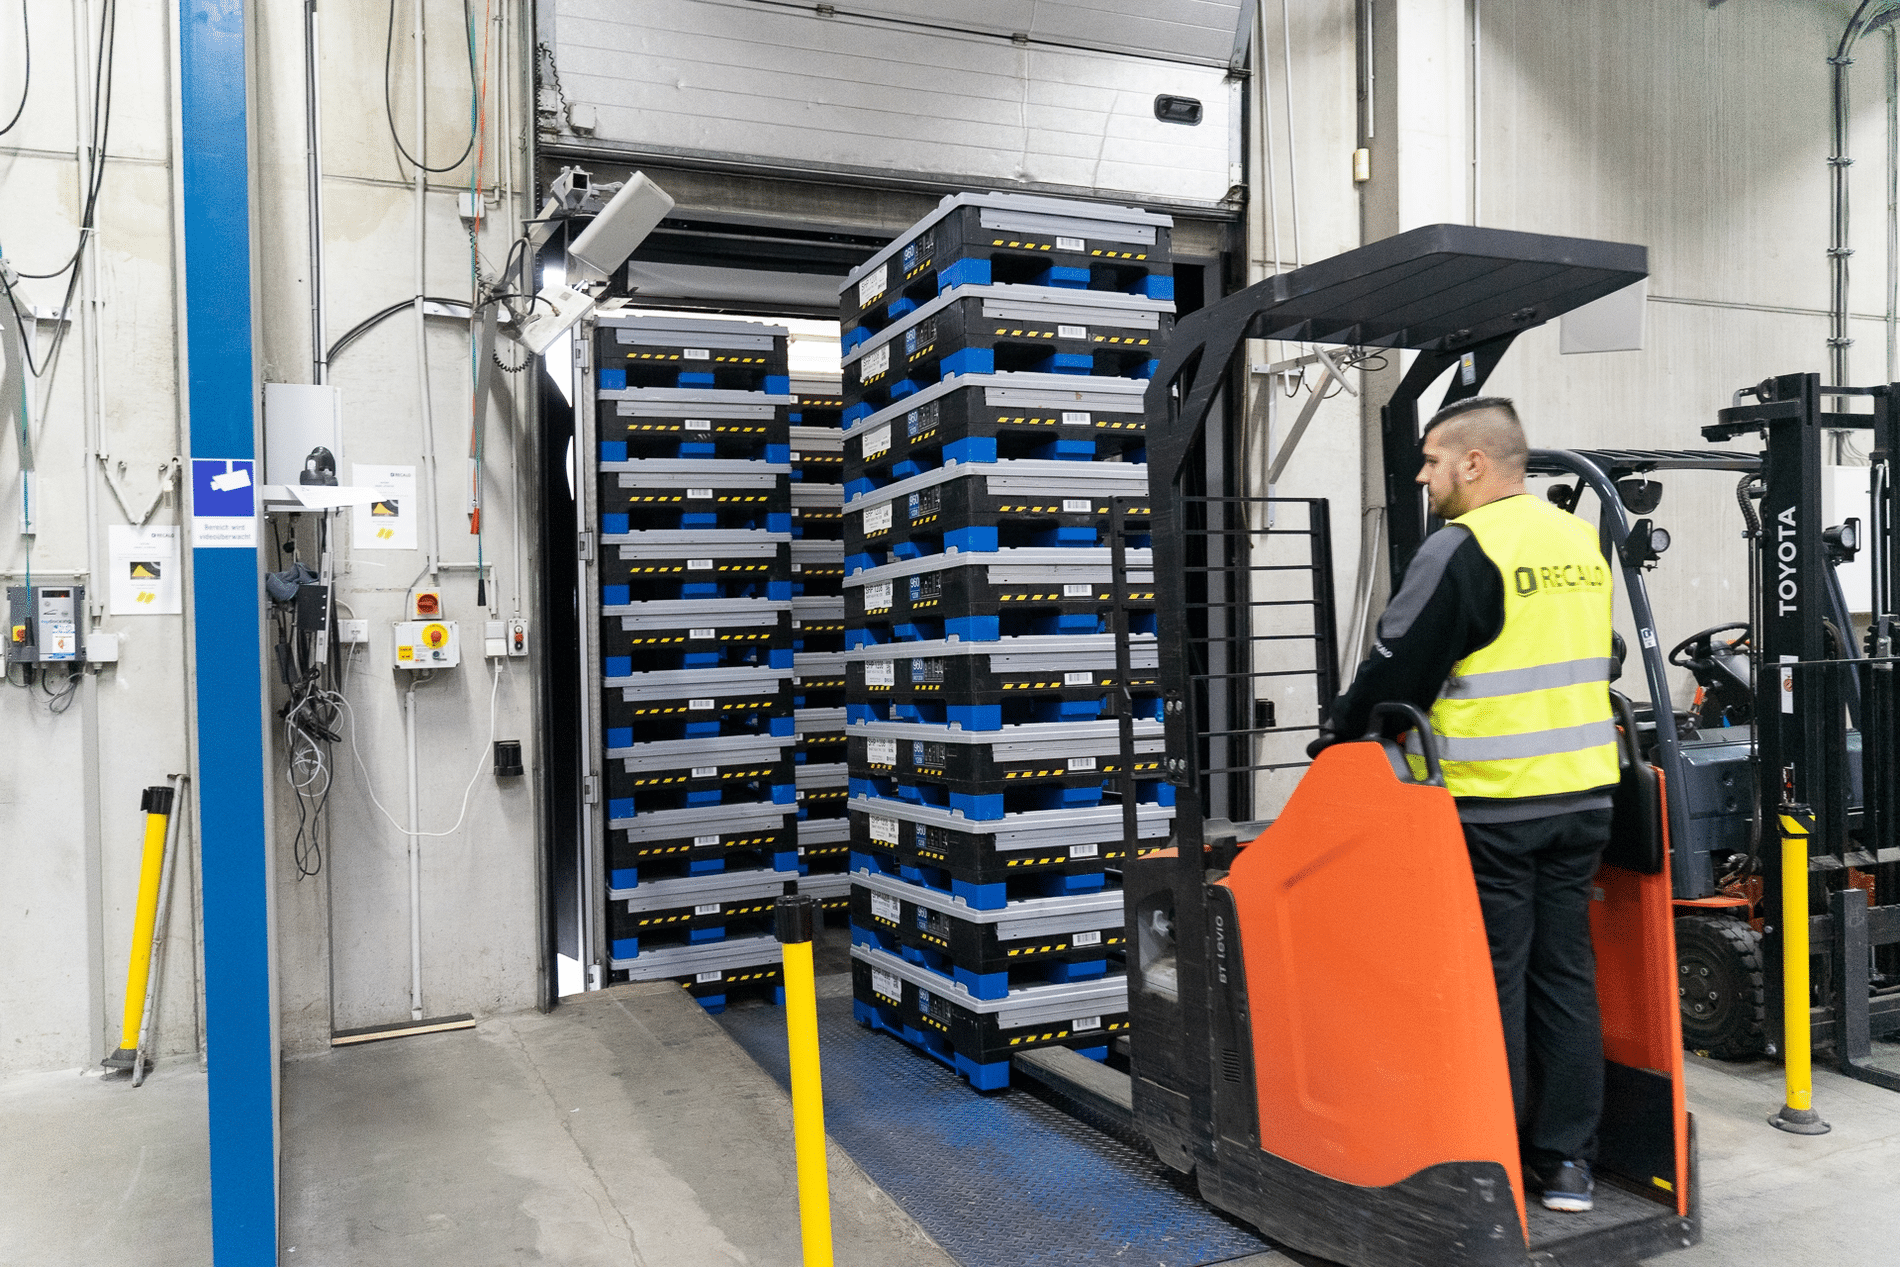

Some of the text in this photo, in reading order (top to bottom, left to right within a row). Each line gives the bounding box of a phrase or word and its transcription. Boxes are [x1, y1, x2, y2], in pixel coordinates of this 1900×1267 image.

[904, 245, 914, 260] 960
[906, 328, 916, 341] 960
[908, 411, 918, 424] 960
[909, 493, 919, 506] 960
[204, 523, 245, 531] Bereich wird
[1778, 506, 1797, 616] TOYOTA
[910, 576, 920, 588] 960
[1540, 565, 1604, 588] RECALO
[912, 658, 923, 670] 960
[913, 741, 924, 753] 960
[916, 823, 926, 836] 960
[917, 906, 927, 919] 960
[1218, 963, 1228, 984] BT
